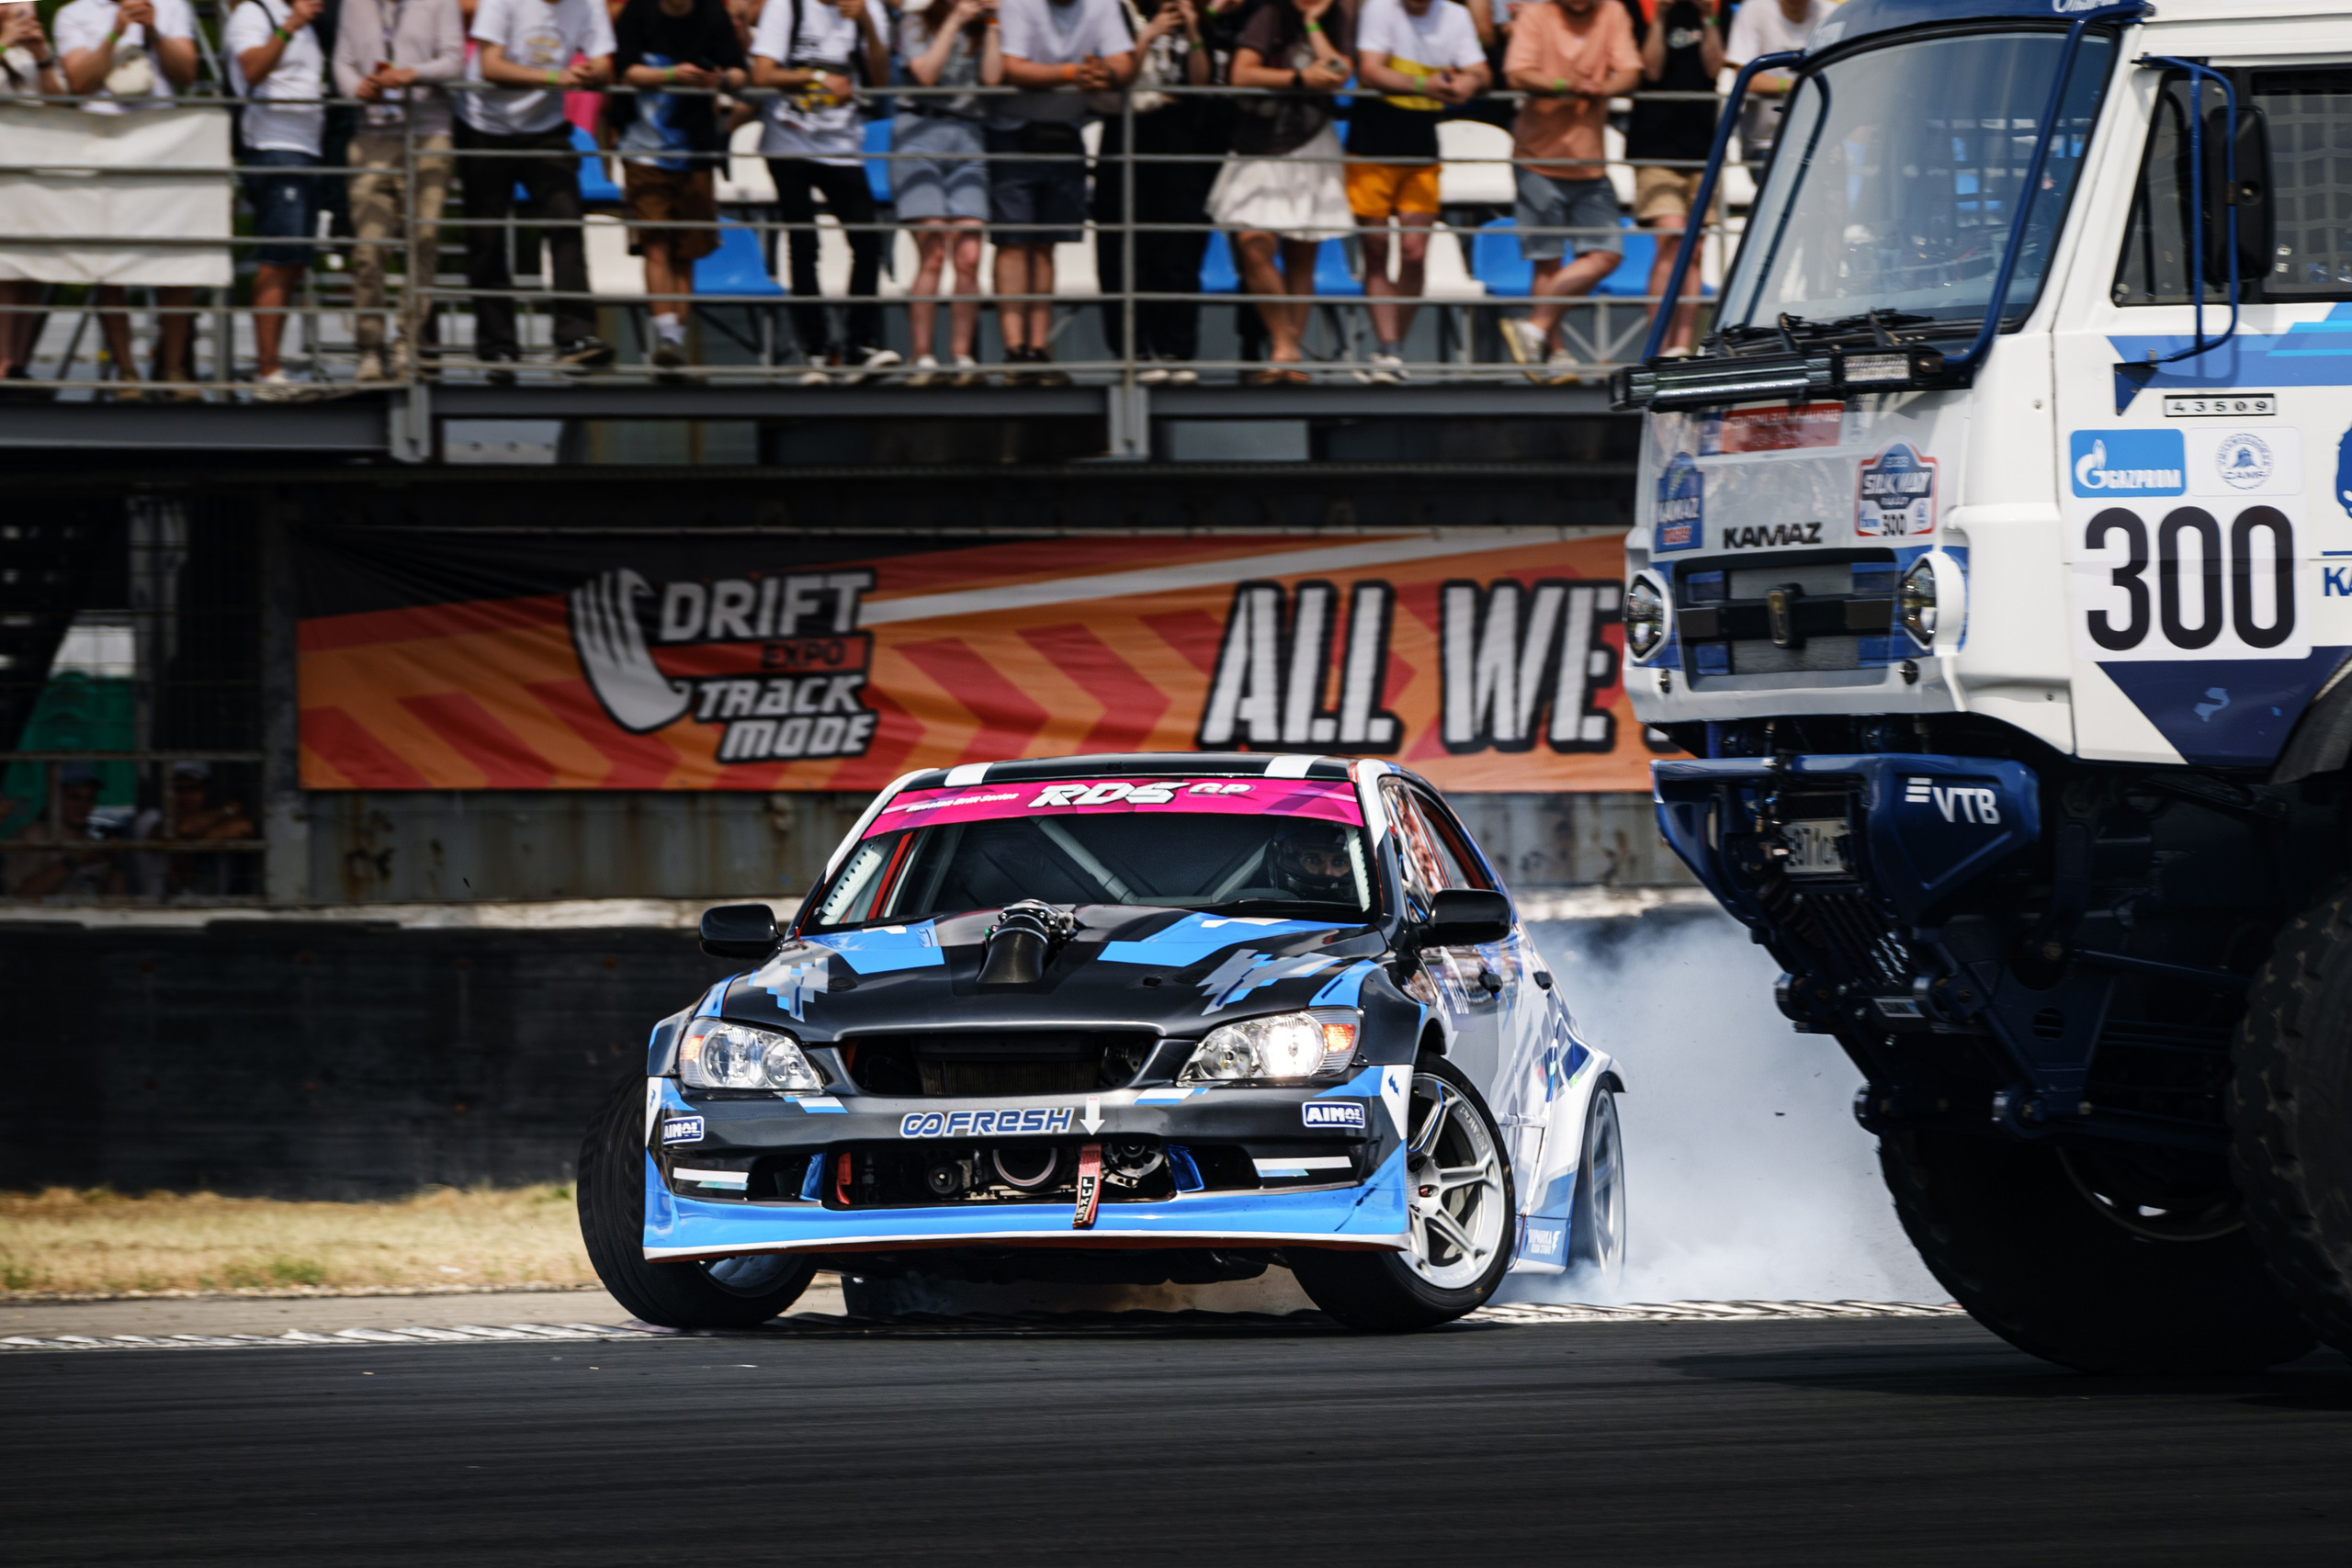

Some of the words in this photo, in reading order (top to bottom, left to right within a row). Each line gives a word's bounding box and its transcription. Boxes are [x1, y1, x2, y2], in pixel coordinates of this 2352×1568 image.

[2173, 400, 2267, 412] 43509
[2107, 469, 2182, 489] GAZPROM
[1723, 522, 1823, 549] KAMAZ
[2086, 504, 2296, 651] 300
[2324, 566, 2352, 597] K
[660, 572, 872, 641] DRIFT
[762, 643, 847, 669] EXPO
[1201, 586, 1394, 742] ALL
[1444, 586, 1622, 742] WE
[696, 674, 866, 719] TRACK
[718, 713, 877, 761] MODE
[1028, 782, 1192, 808] RDS
[1189, 783, 1251, 795] GP
[1932, 787, 2001, 825] VTB
[944, 1108, 1074, 1136] FRESH
[1306, 1107, 1363, 1122] AIMOL
[664, 1122, 701, 1139] AIMOL
